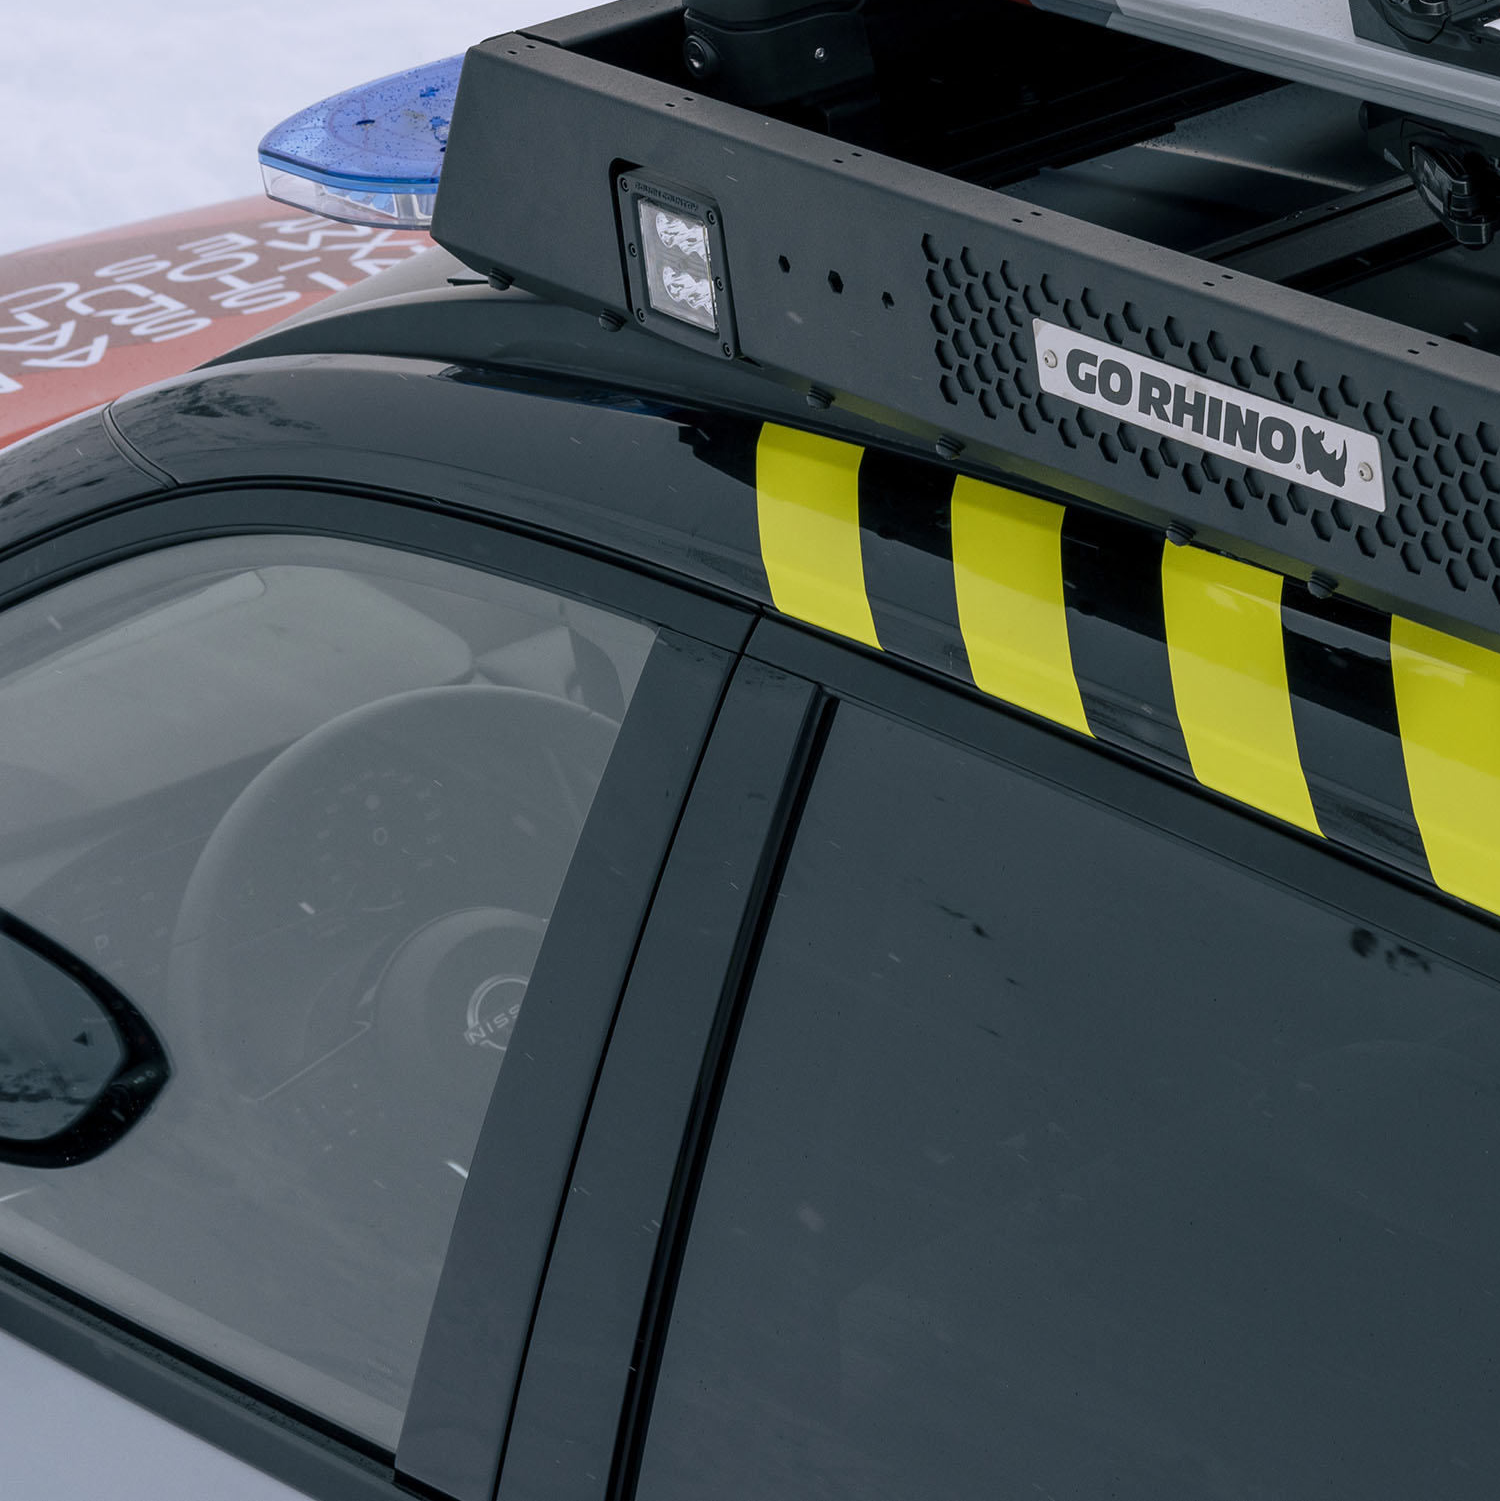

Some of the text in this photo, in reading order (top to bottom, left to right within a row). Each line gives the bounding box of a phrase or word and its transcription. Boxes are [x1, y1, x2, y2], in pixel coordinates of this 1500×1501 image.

[0, 245, 428, 394] NISSA
[1065, 347, 1298, 465] GO RHINO
[468, 1003, 520, 1045] NISS
